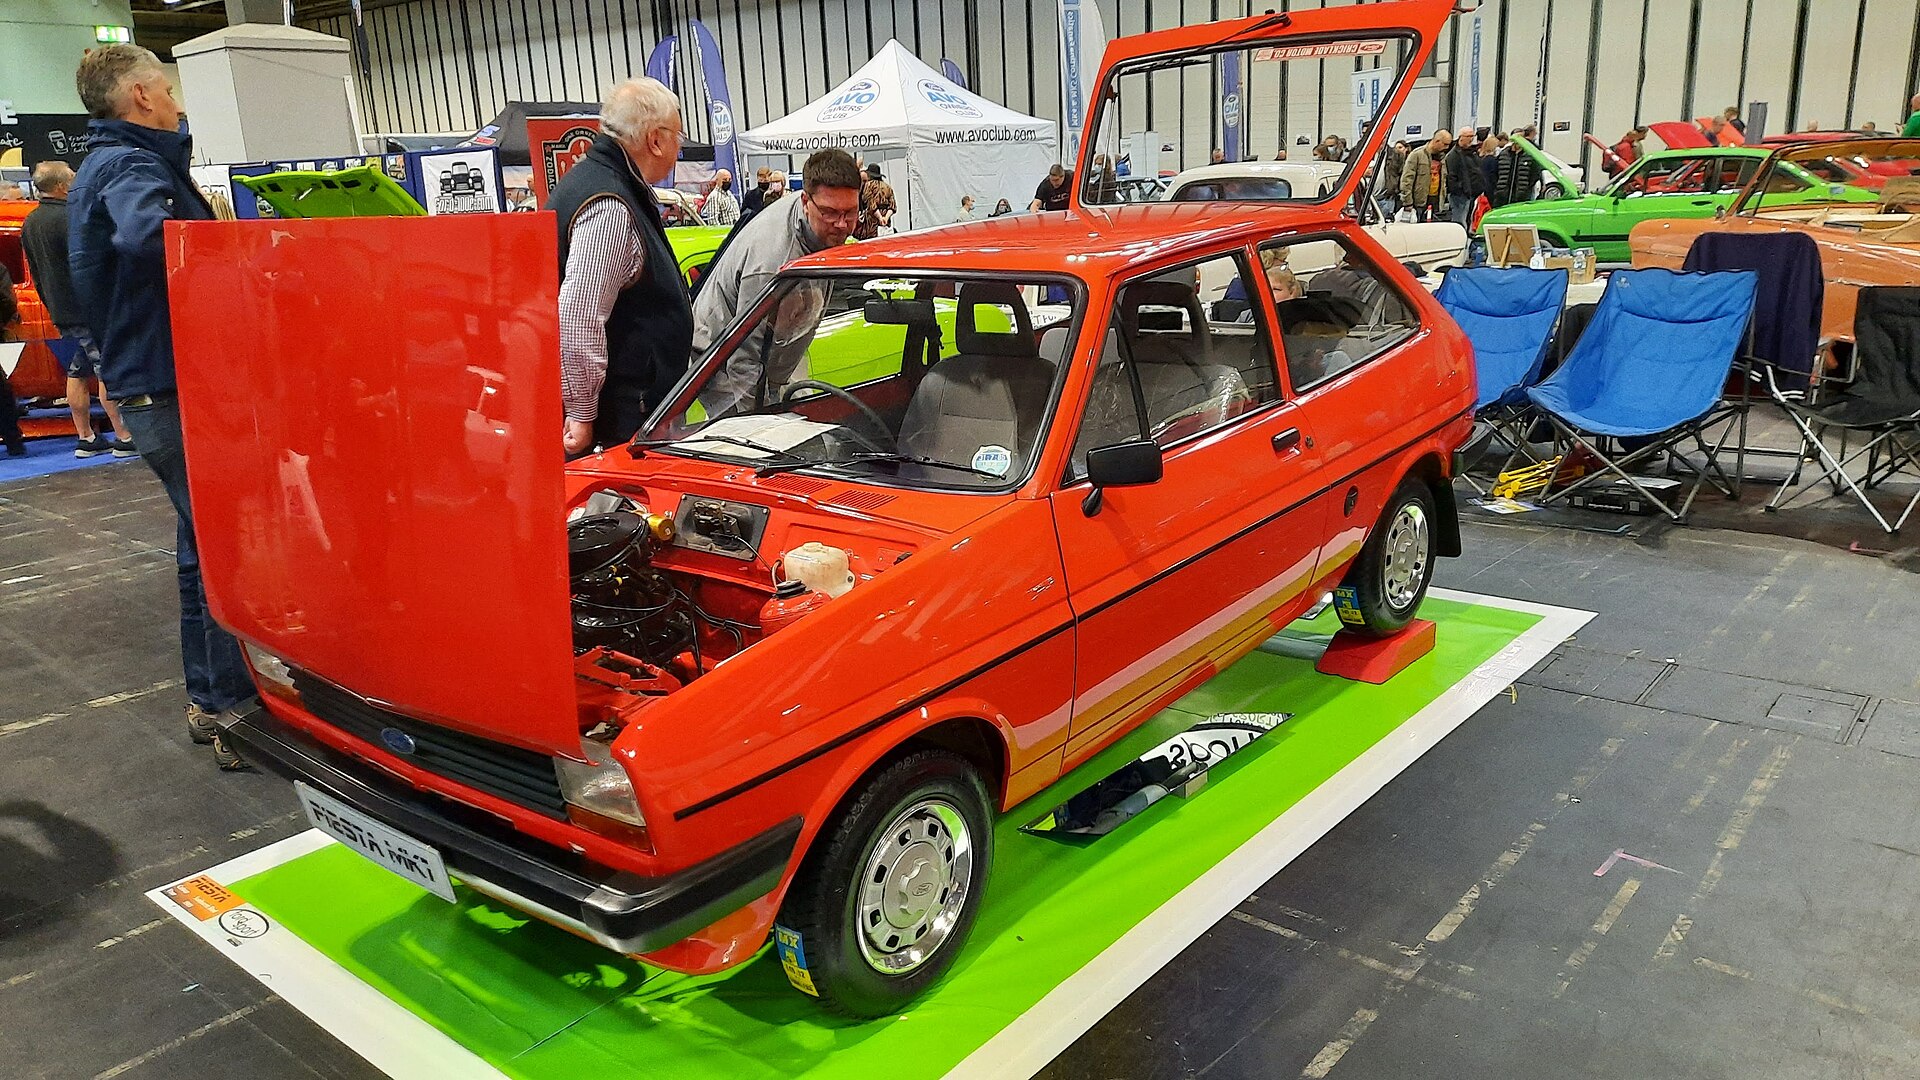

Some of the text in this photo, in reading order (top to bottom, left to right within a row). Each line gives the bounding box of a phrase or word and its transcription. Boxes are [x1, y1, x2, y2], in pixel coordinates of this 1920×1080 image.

[1286, 47, 1314, 57] MOTOR
[1314, 44, 1358, 55] CRICKLADE
[832, 92, 875, 106] AVO
[927, 91, 967, 106] AVO
[823, 105, 863, 116] OWNERS
[762, 132, 881, 151] www.avoclub.com
[935, 125, 1037, 144] www.avoclub.com
[546, 156, 556, 190] ZODIAC
[309, 799, 436, 882] FIESTA MK1
[190, 877, 231, 903] FIESTA
